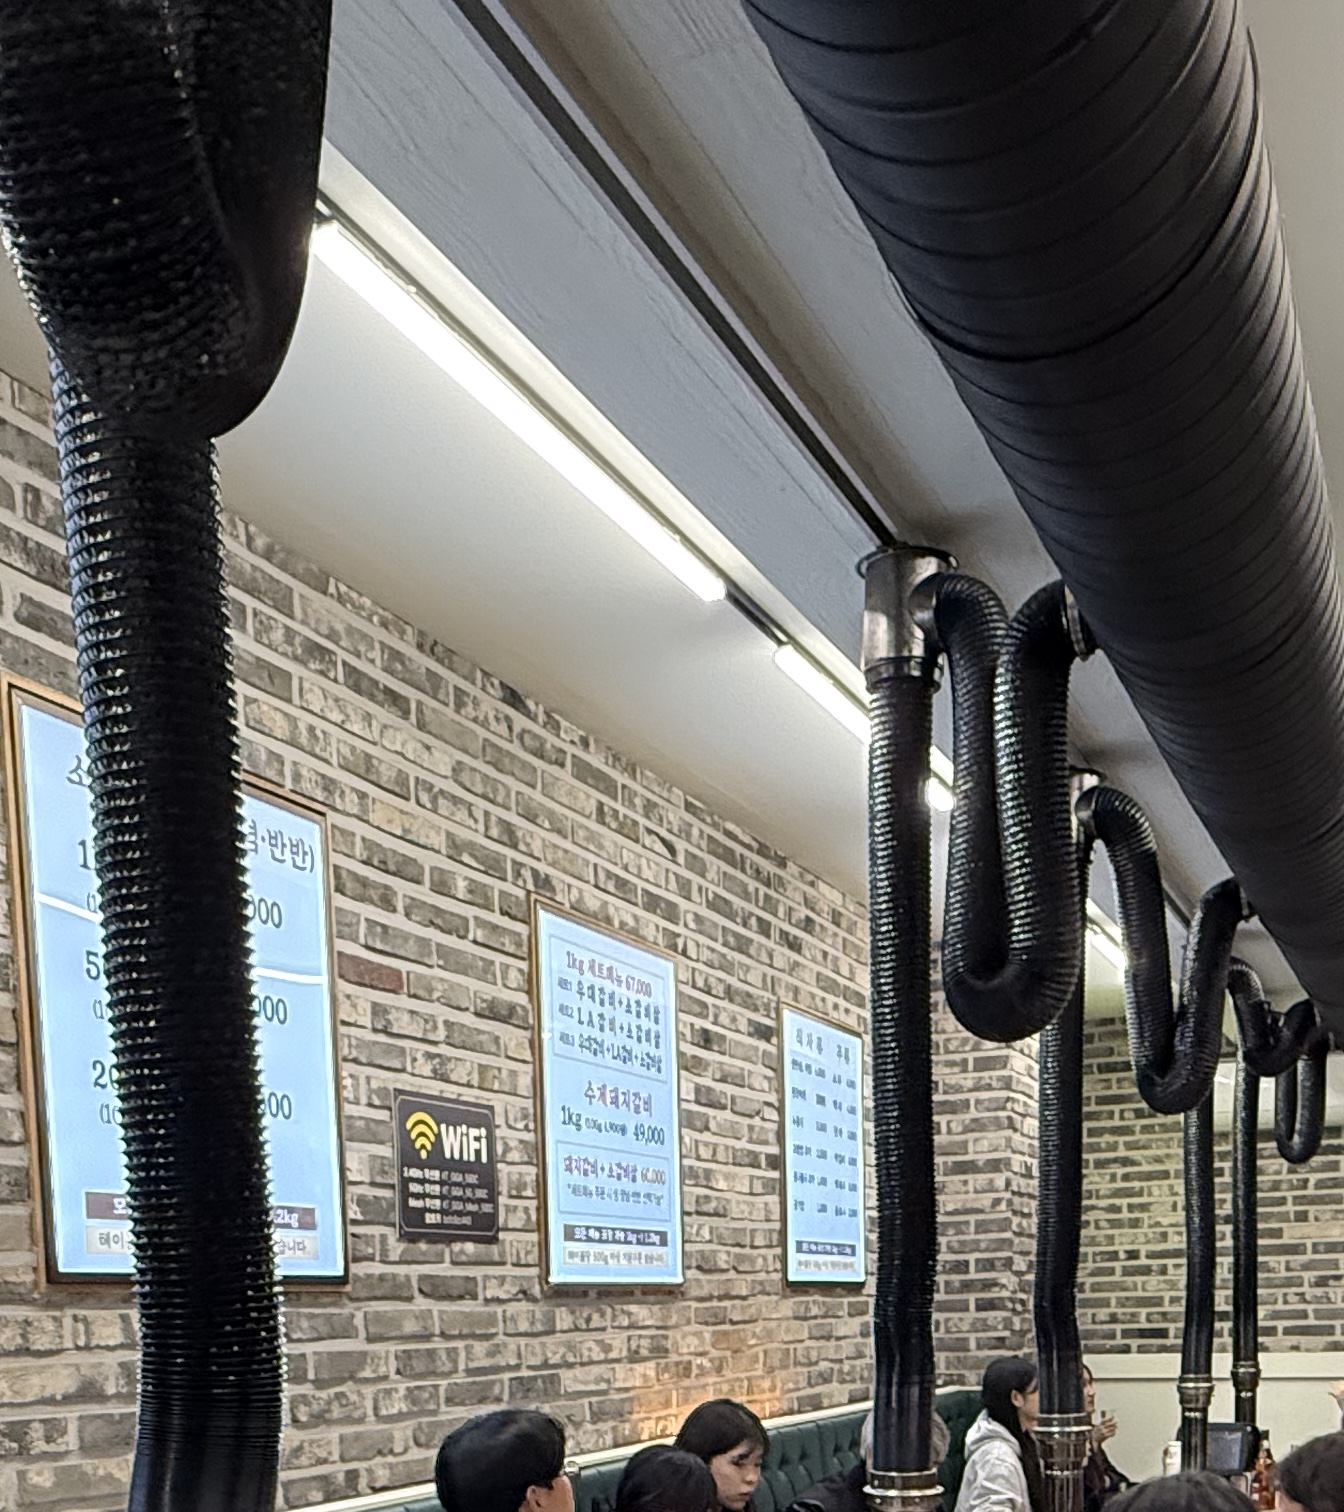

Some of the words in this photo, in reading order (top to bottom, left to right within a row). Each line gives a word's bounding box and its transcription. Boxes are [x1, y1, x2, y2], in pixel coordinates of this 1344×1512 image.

[566, 951, 585, 976] 1kg
[440, 1122, 488, 1164] WiFi
[561, 1104, 582, 1132] 1kg
[633, 1122, 665, 1145] 49,000
